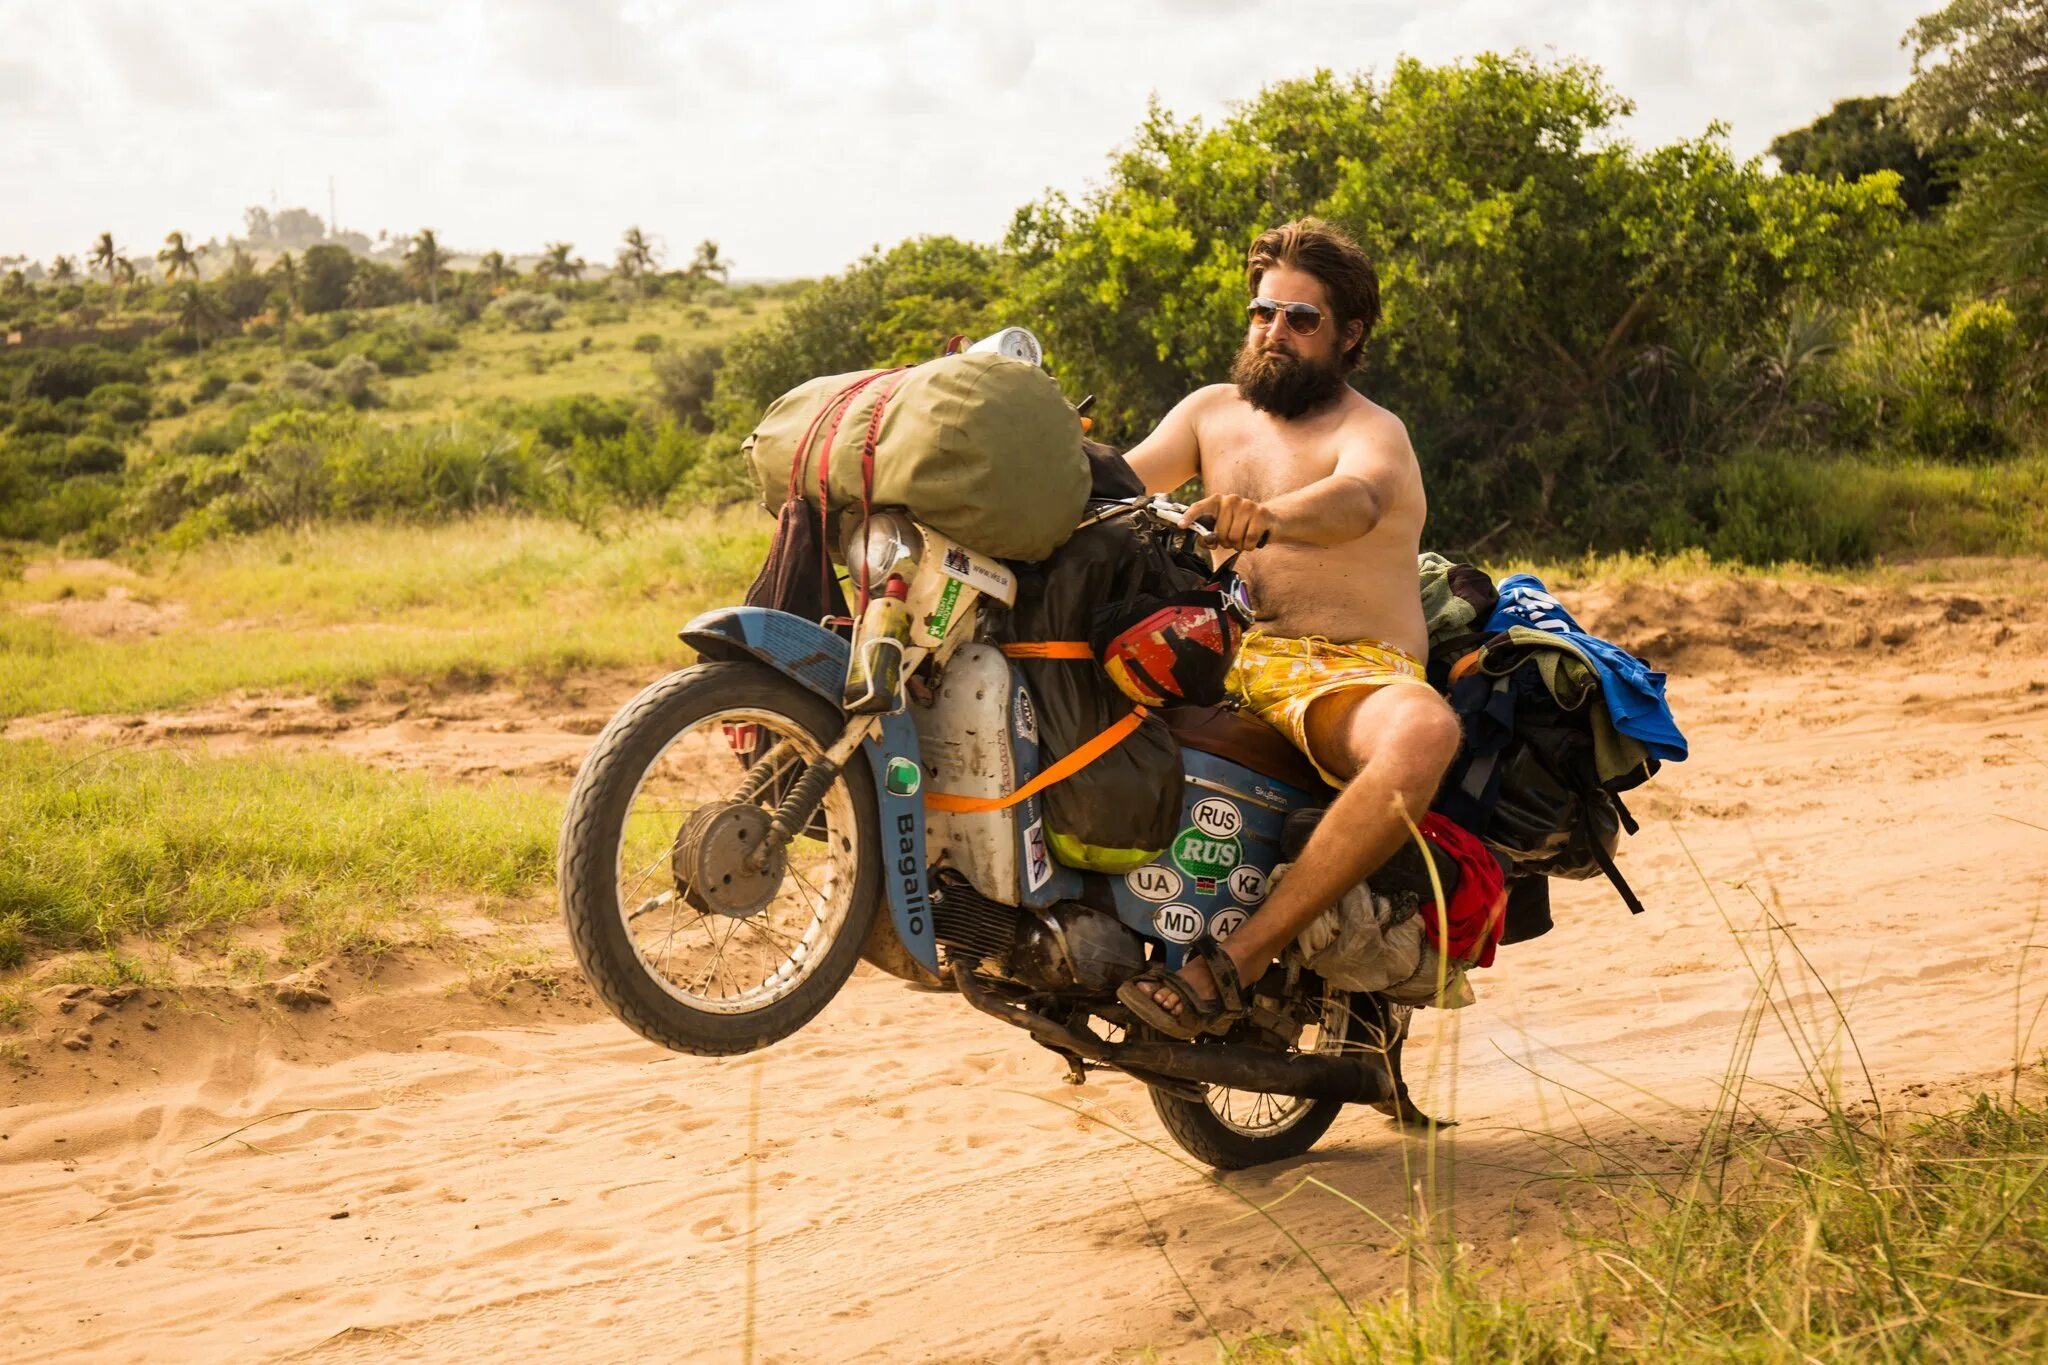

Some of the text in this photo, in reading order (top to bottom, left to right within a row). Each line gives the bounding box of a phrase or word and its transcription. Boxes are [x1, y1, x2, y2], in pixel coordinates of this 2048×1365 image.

[1198, 805, 1236, 831] RUS
[1181, 837, 1237, 867] RUS
[897, 813, 926, 936] Bagalio
[1137, 872, 1170, 894] UA
[1238, 873, 1260, 897] KZ
[1164, 911, 1196, 935] MD
[1216, 917, 1243, 936] AZ
